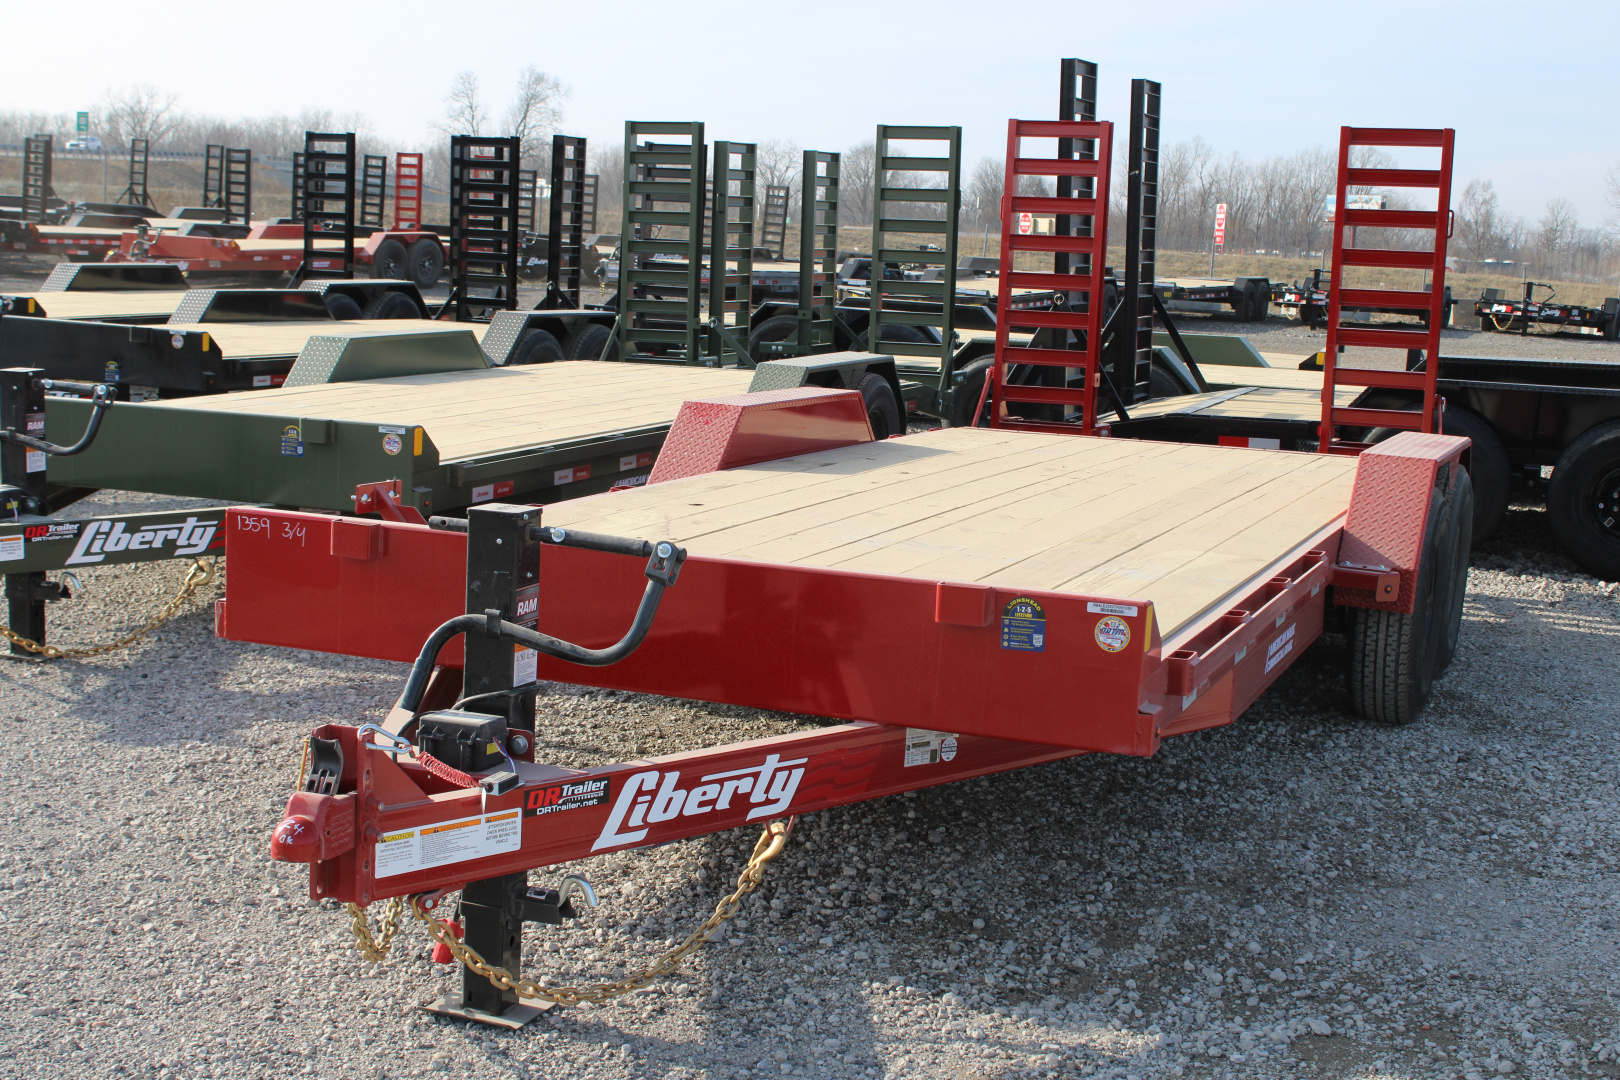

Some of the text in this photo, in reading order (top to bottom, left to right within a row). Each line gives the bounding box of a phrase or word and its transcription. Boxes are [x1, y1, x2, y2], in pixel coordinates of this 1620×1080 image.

[27, 421, 44, 431] RAM
[25, 523, 80, 539] DR Trailer
[31, 534, 73, 543] DRTrailer.net
[238, 515, 306, 547] 1359 3/4
[64, 517, 219, 566] Liberty
[517, 597, 538, 617] RAM
[1007, 597, 1041, 611] LIONSHEAD
[527, 780, 608, 810] DR Trailer
[590, 753, 808, 853] Liberty
[537, 798, 598, 815] DRTrailer.net
[386, 832, 414, 842] CAUTION
